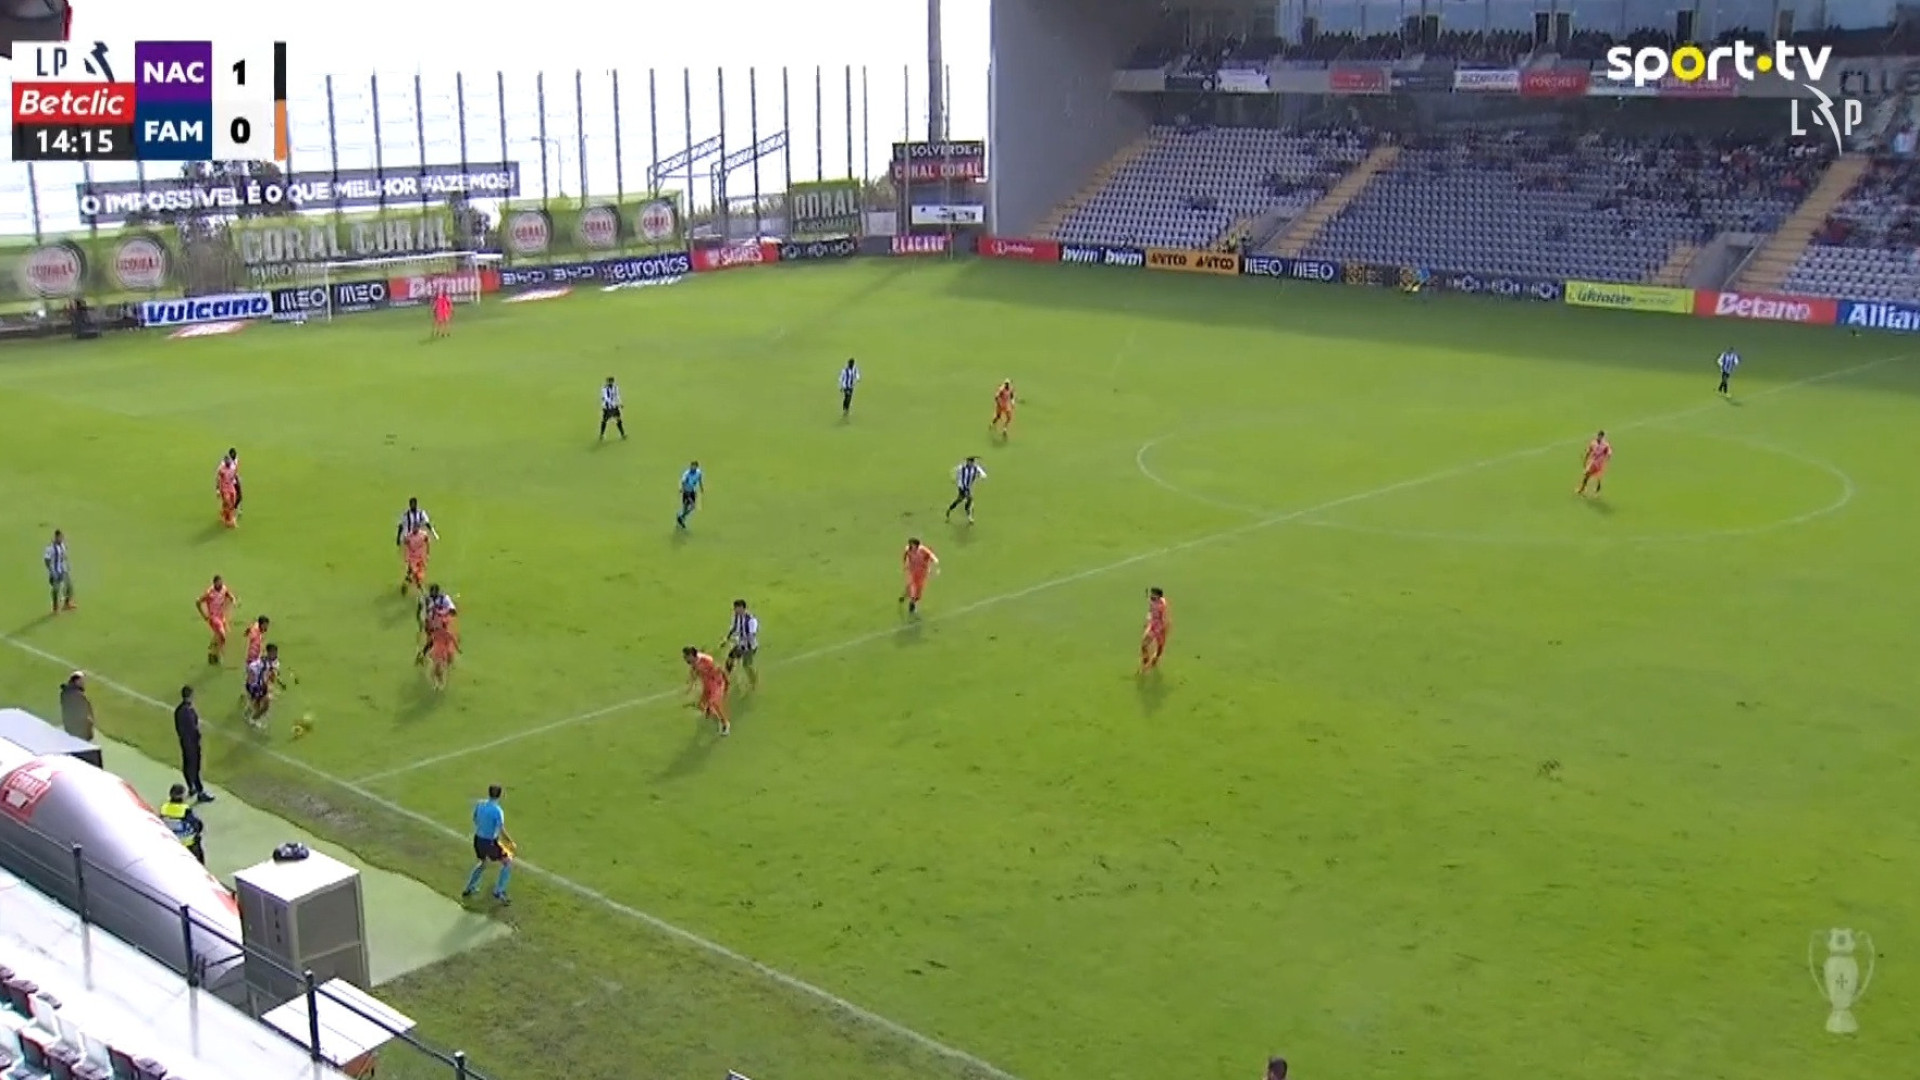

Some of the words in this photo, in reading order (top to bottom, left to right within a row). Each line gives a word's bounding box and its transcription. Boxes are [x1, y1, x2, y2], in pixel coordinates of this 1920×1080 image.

[81, 195, 100, 215] O
[104, 184, 243, 214] IMPOSSÍVEL
[247, 179, 262, 205] É
[265, 184, 283, 203] O
[287, 181, 330, 206] QUE
[335, 176, 418, 200] MELHOR
[420, 171, 515, 194] FAZEMOS!
[614, 256, 689, 280] euronics
[280, 287, 328, 311] MEO
[340, 283, 385, 306] MEO
[1714, 291, 1812, 322] Betano
[147, 297, 269, 323] Vulcano
